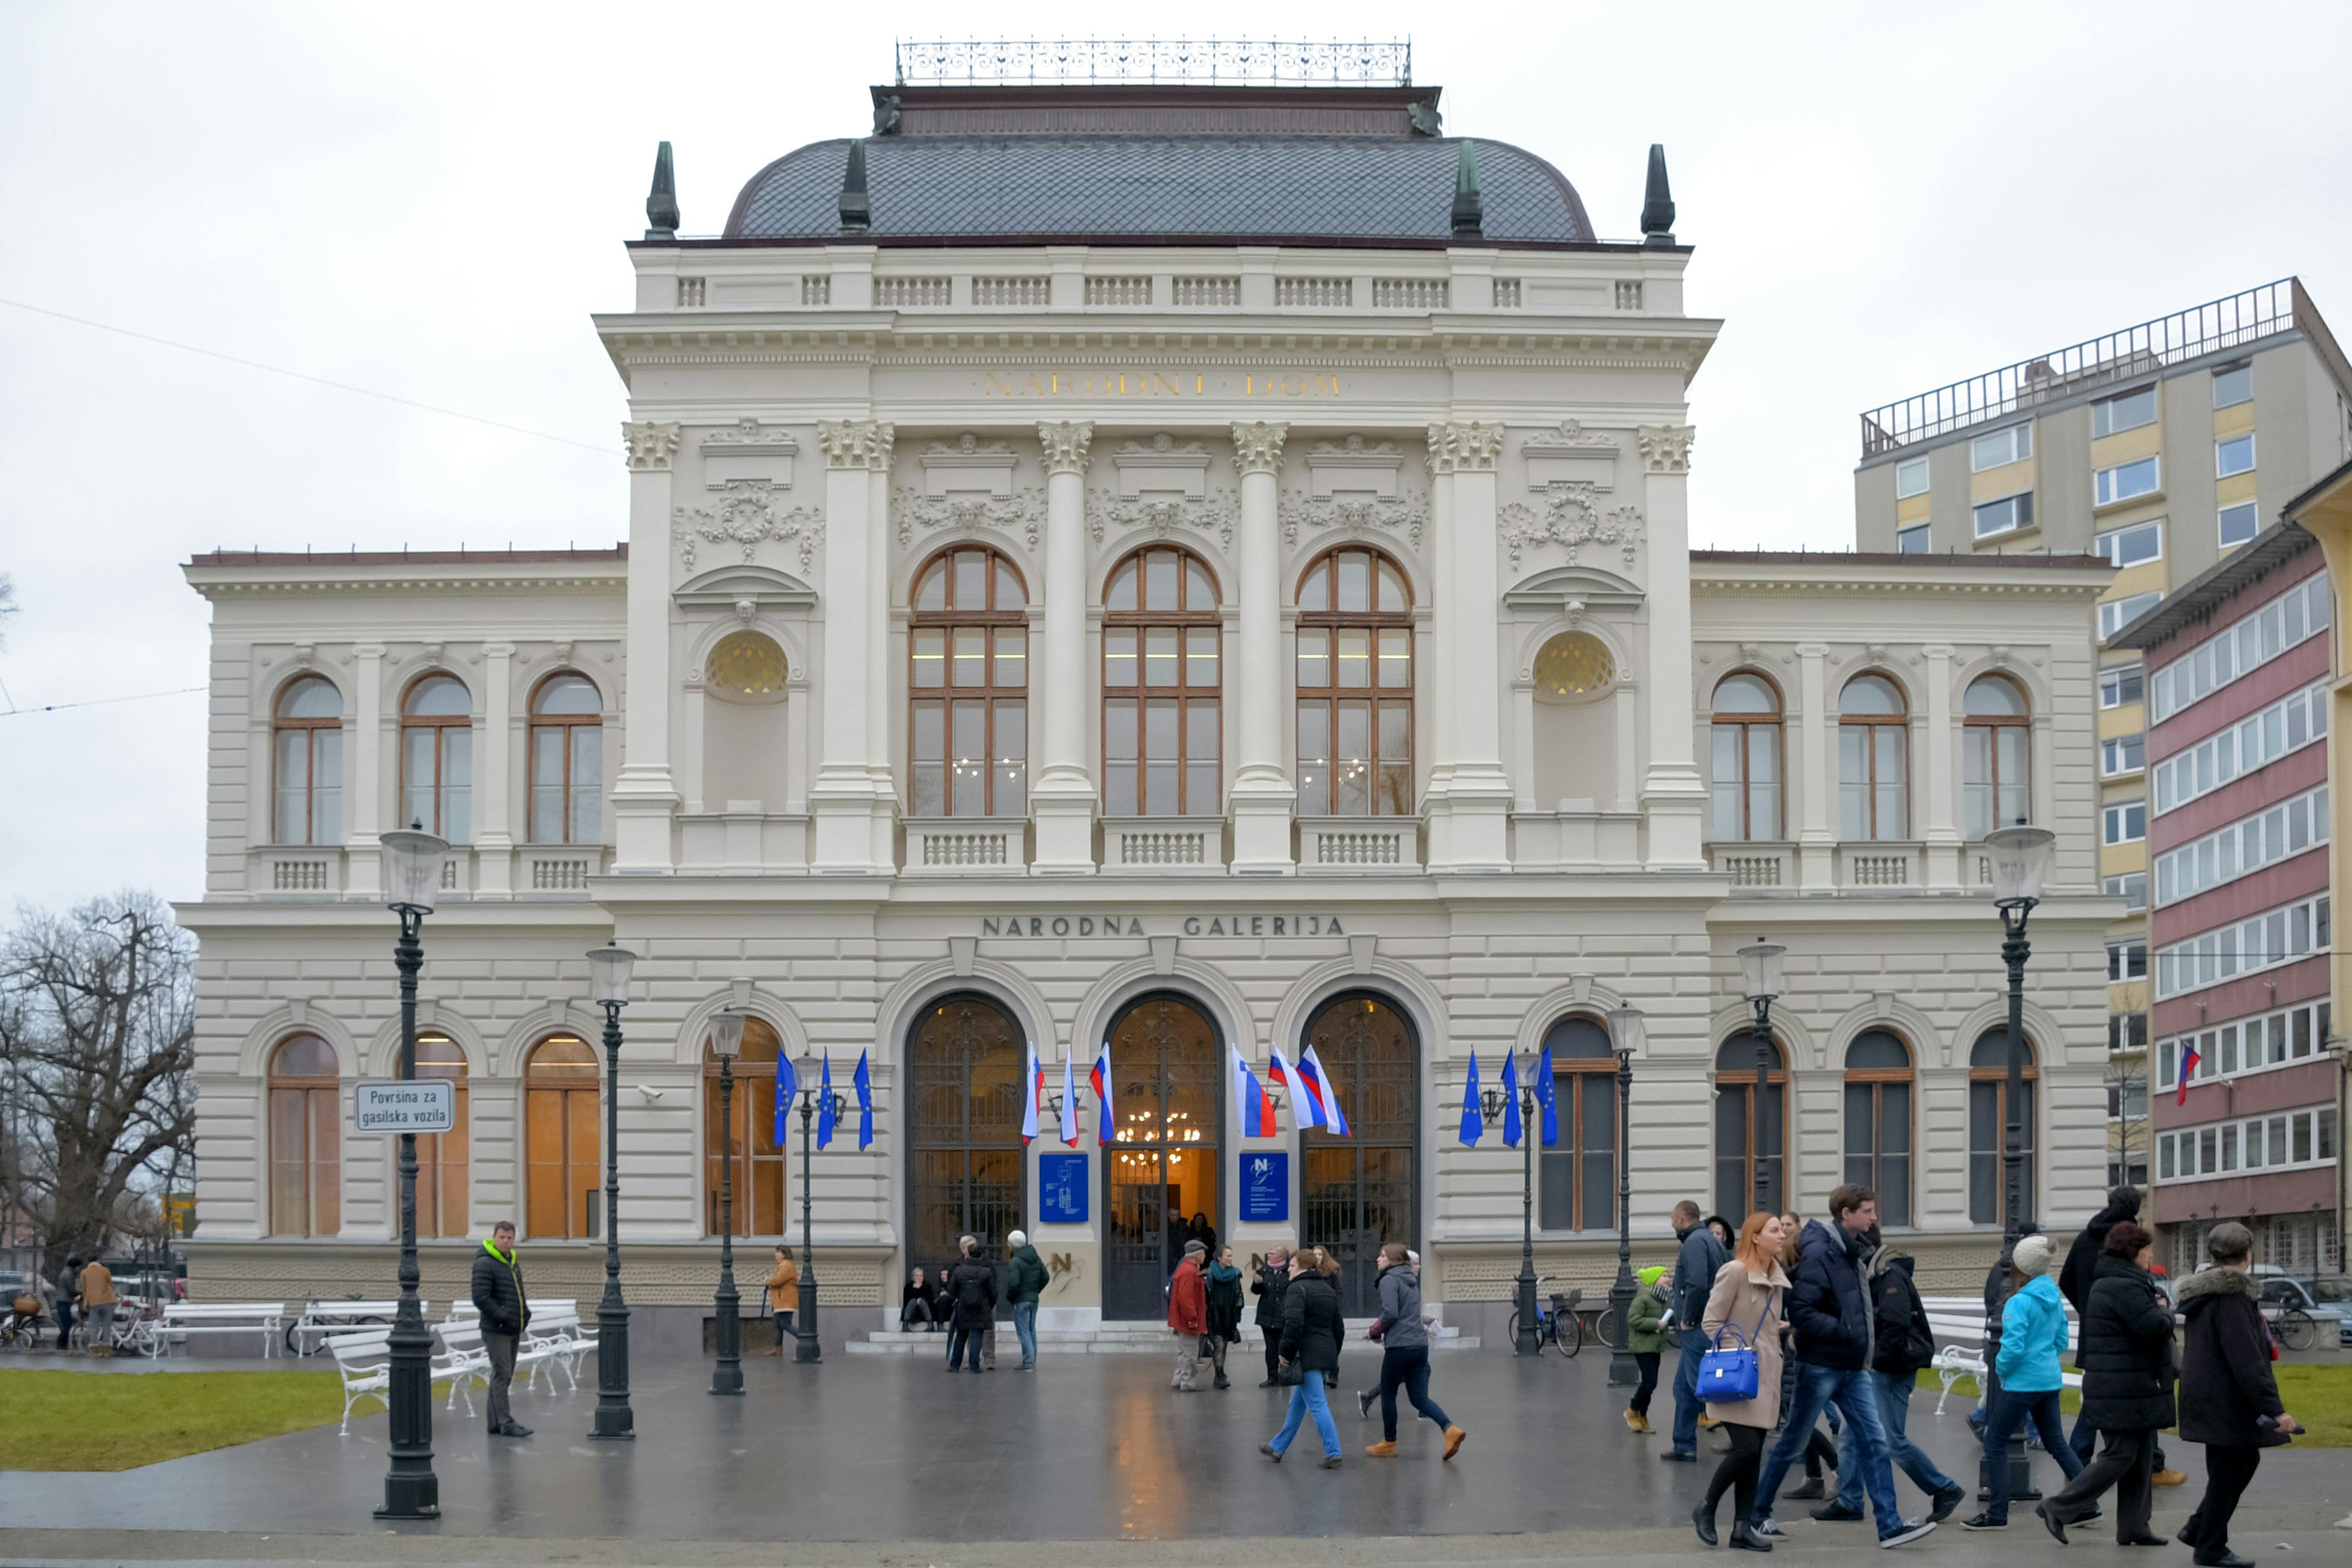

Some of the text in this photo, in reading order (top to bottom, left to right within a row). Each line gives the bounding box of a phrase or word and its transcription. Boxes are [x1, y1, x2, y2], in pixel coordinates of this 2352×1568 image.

[984, 372, 1339, 397] NARODNI DOM
[983, 917, 1344, 936] NARODNA GALERIJA
[370, 1090, 436, 1103] Površina za
[363, 1109, 446, 1126] gasilska vozila
